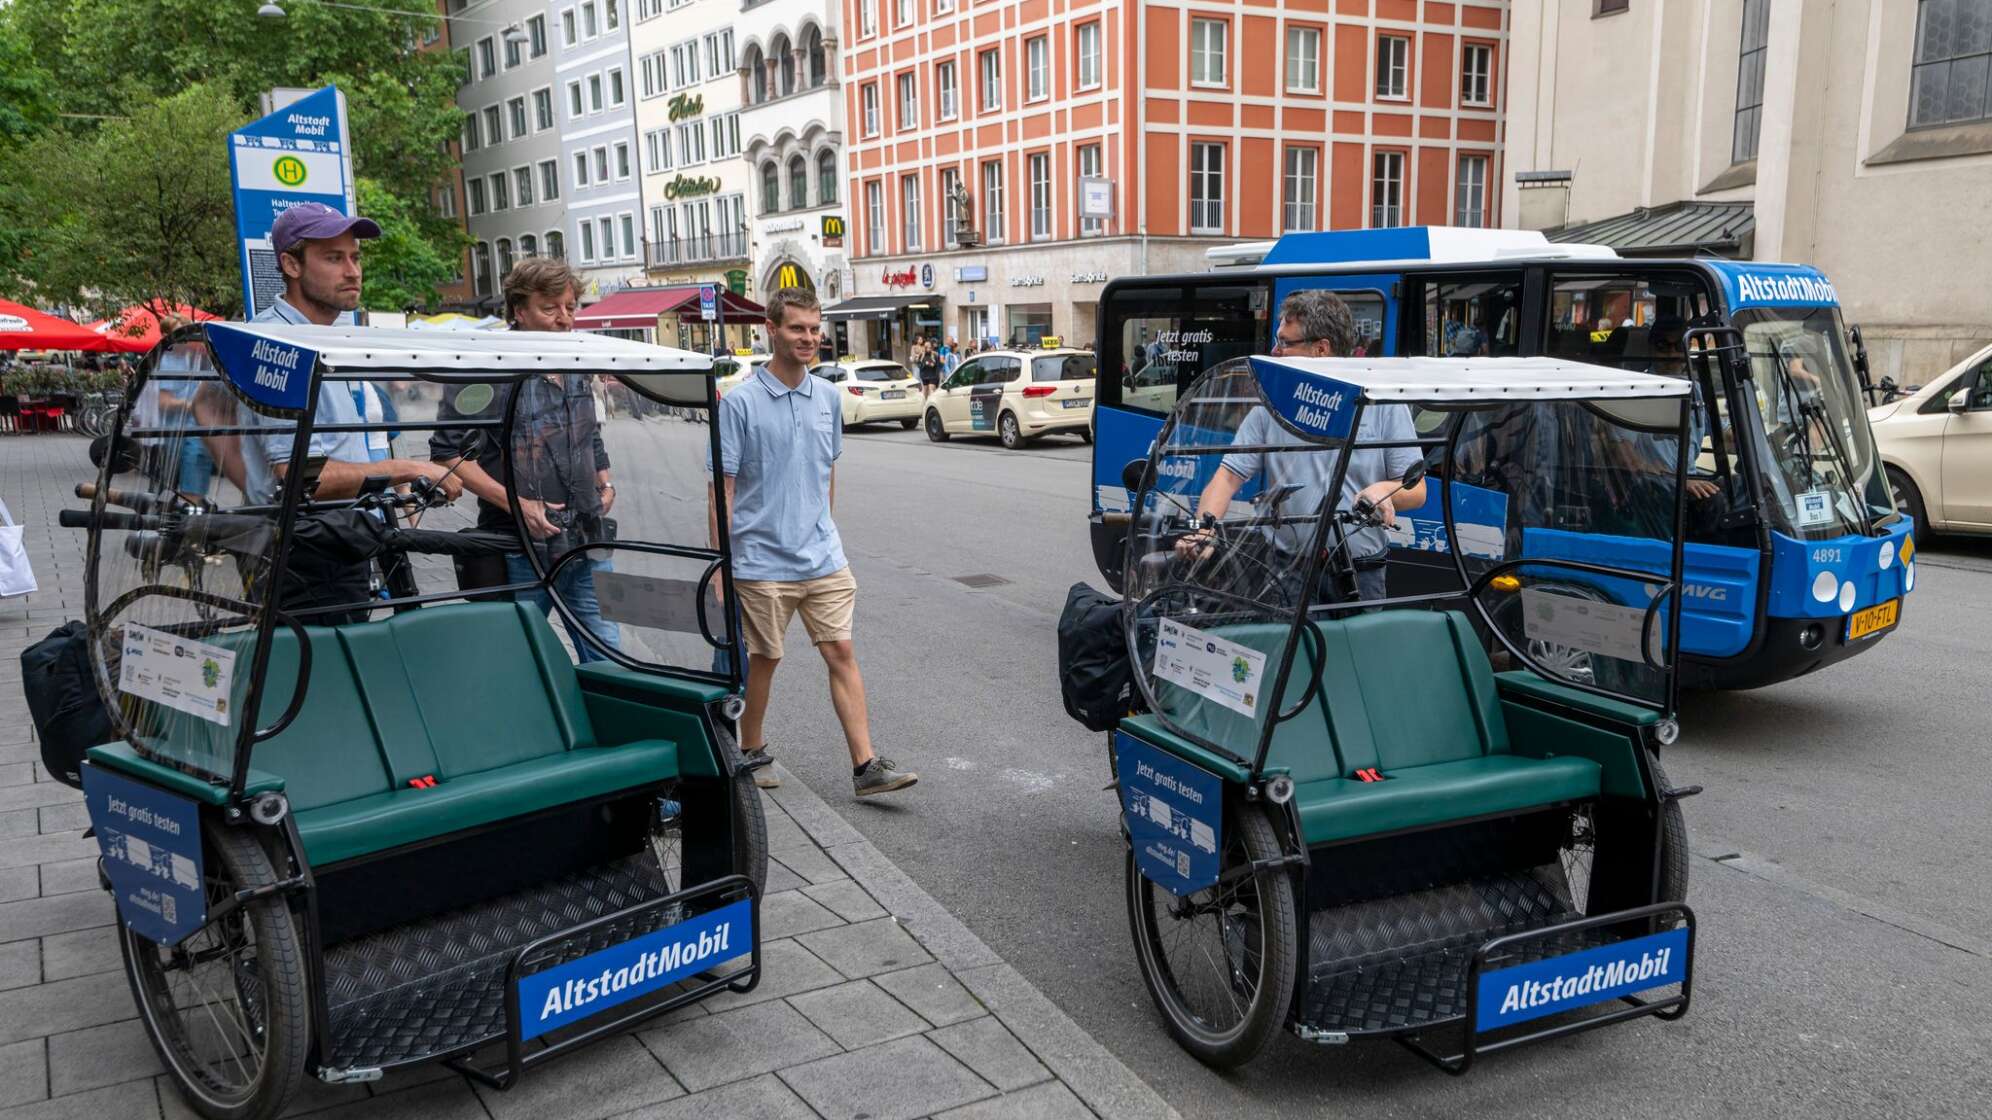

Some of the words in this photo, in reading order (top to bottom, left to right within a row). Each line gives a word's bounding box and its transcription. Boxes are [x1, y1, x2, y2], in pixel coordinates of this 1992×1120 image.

[287, 113, 330, 127] Altstadt
[295, 124, 325, 136] Mobil
[283, 161, 298, 180] H
[1156, 330, 1180, 344] Jetzt
[1182, 328, 1212, 346] gratis
[251, 339, 300, 370] Altstadt
[1168, 349, 1199, 362] testen
[254, 365, 289, 392] Mobil
[1293, 382, 1342, 411] Altstadt
[1295, 405, 1331, 431] Mobil
[1812, 549, 1842, 563] 4891
[1856, 604, 1892, 633] V-10-FTL
[1136, 760, 1154, 779] Jetzt
[1154, 772, 1177, 791] gratis
[1178, 781, 1203, 804] testen
[108, 794, 127, 816] Jetzt
[128, 805, 152, 825] gratis
[154, 813, 180, 835] testen
[540, 922, 731, 1011] AltstadtMobil
[1500, 948, 1671, 1014] AltstadtMobil
